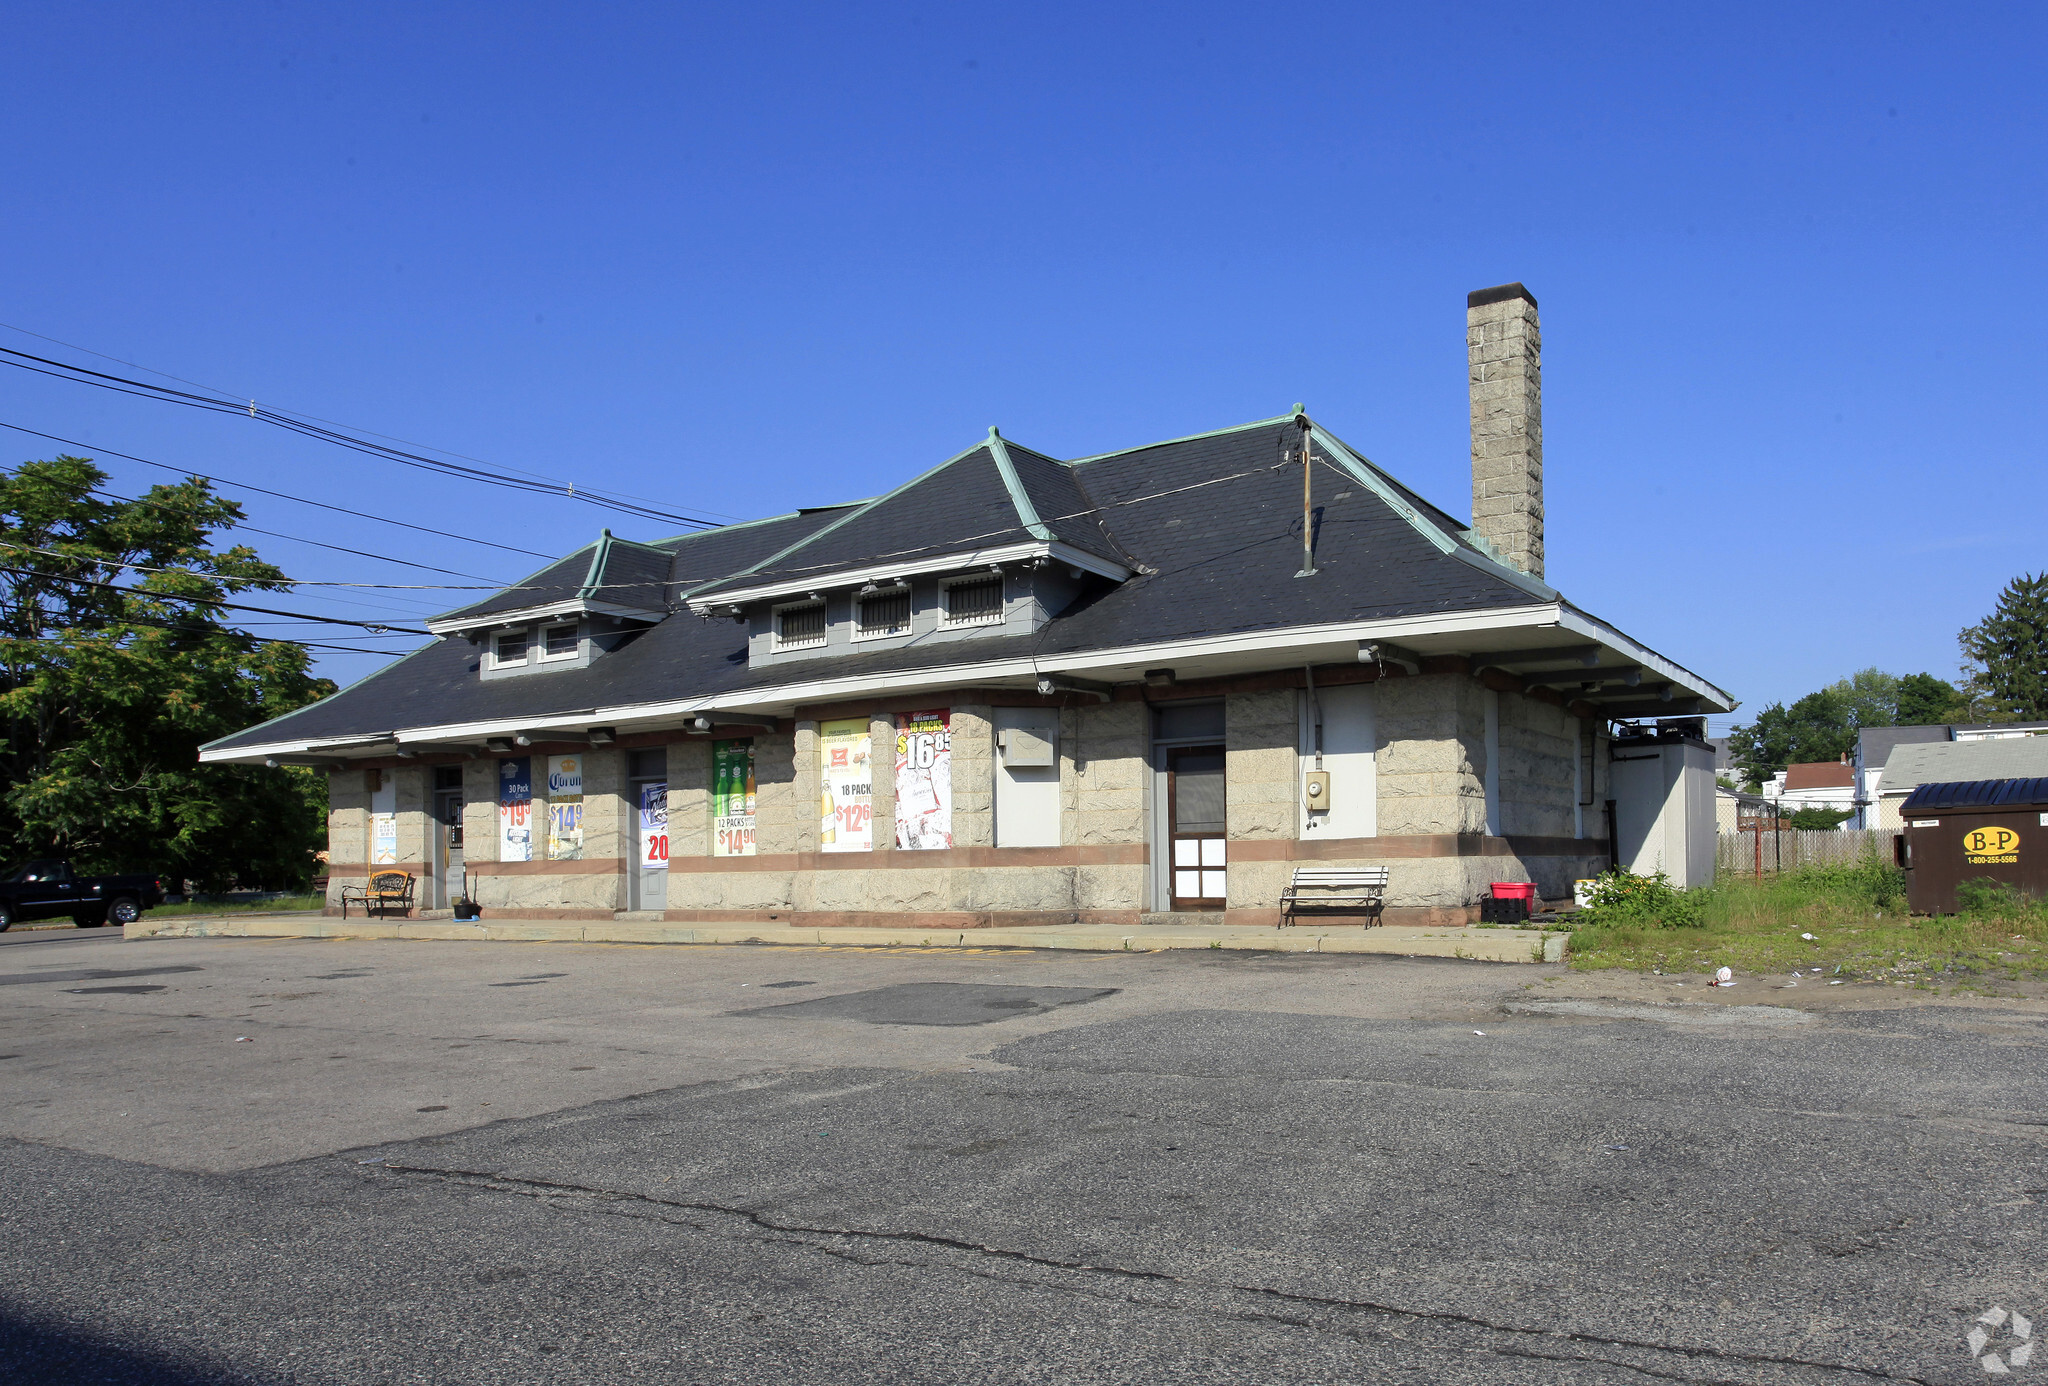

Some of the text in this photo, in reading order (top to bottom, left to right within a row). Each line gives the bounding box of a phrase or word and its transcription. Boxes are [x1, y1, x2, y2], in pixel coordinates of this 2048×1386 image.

[909, 720, 943, 733] 18 PACKS
[509, 783, 529, 793] 30 Pack
[842, 783, 872, 795] 18 PACK
[718, 819, 725, 828] 12
[726, 817, 745, 828] PACKS
[1971, 831, 2012, 851] B-P
[1967, 855, 2018, 864] 1-800-255-5566
